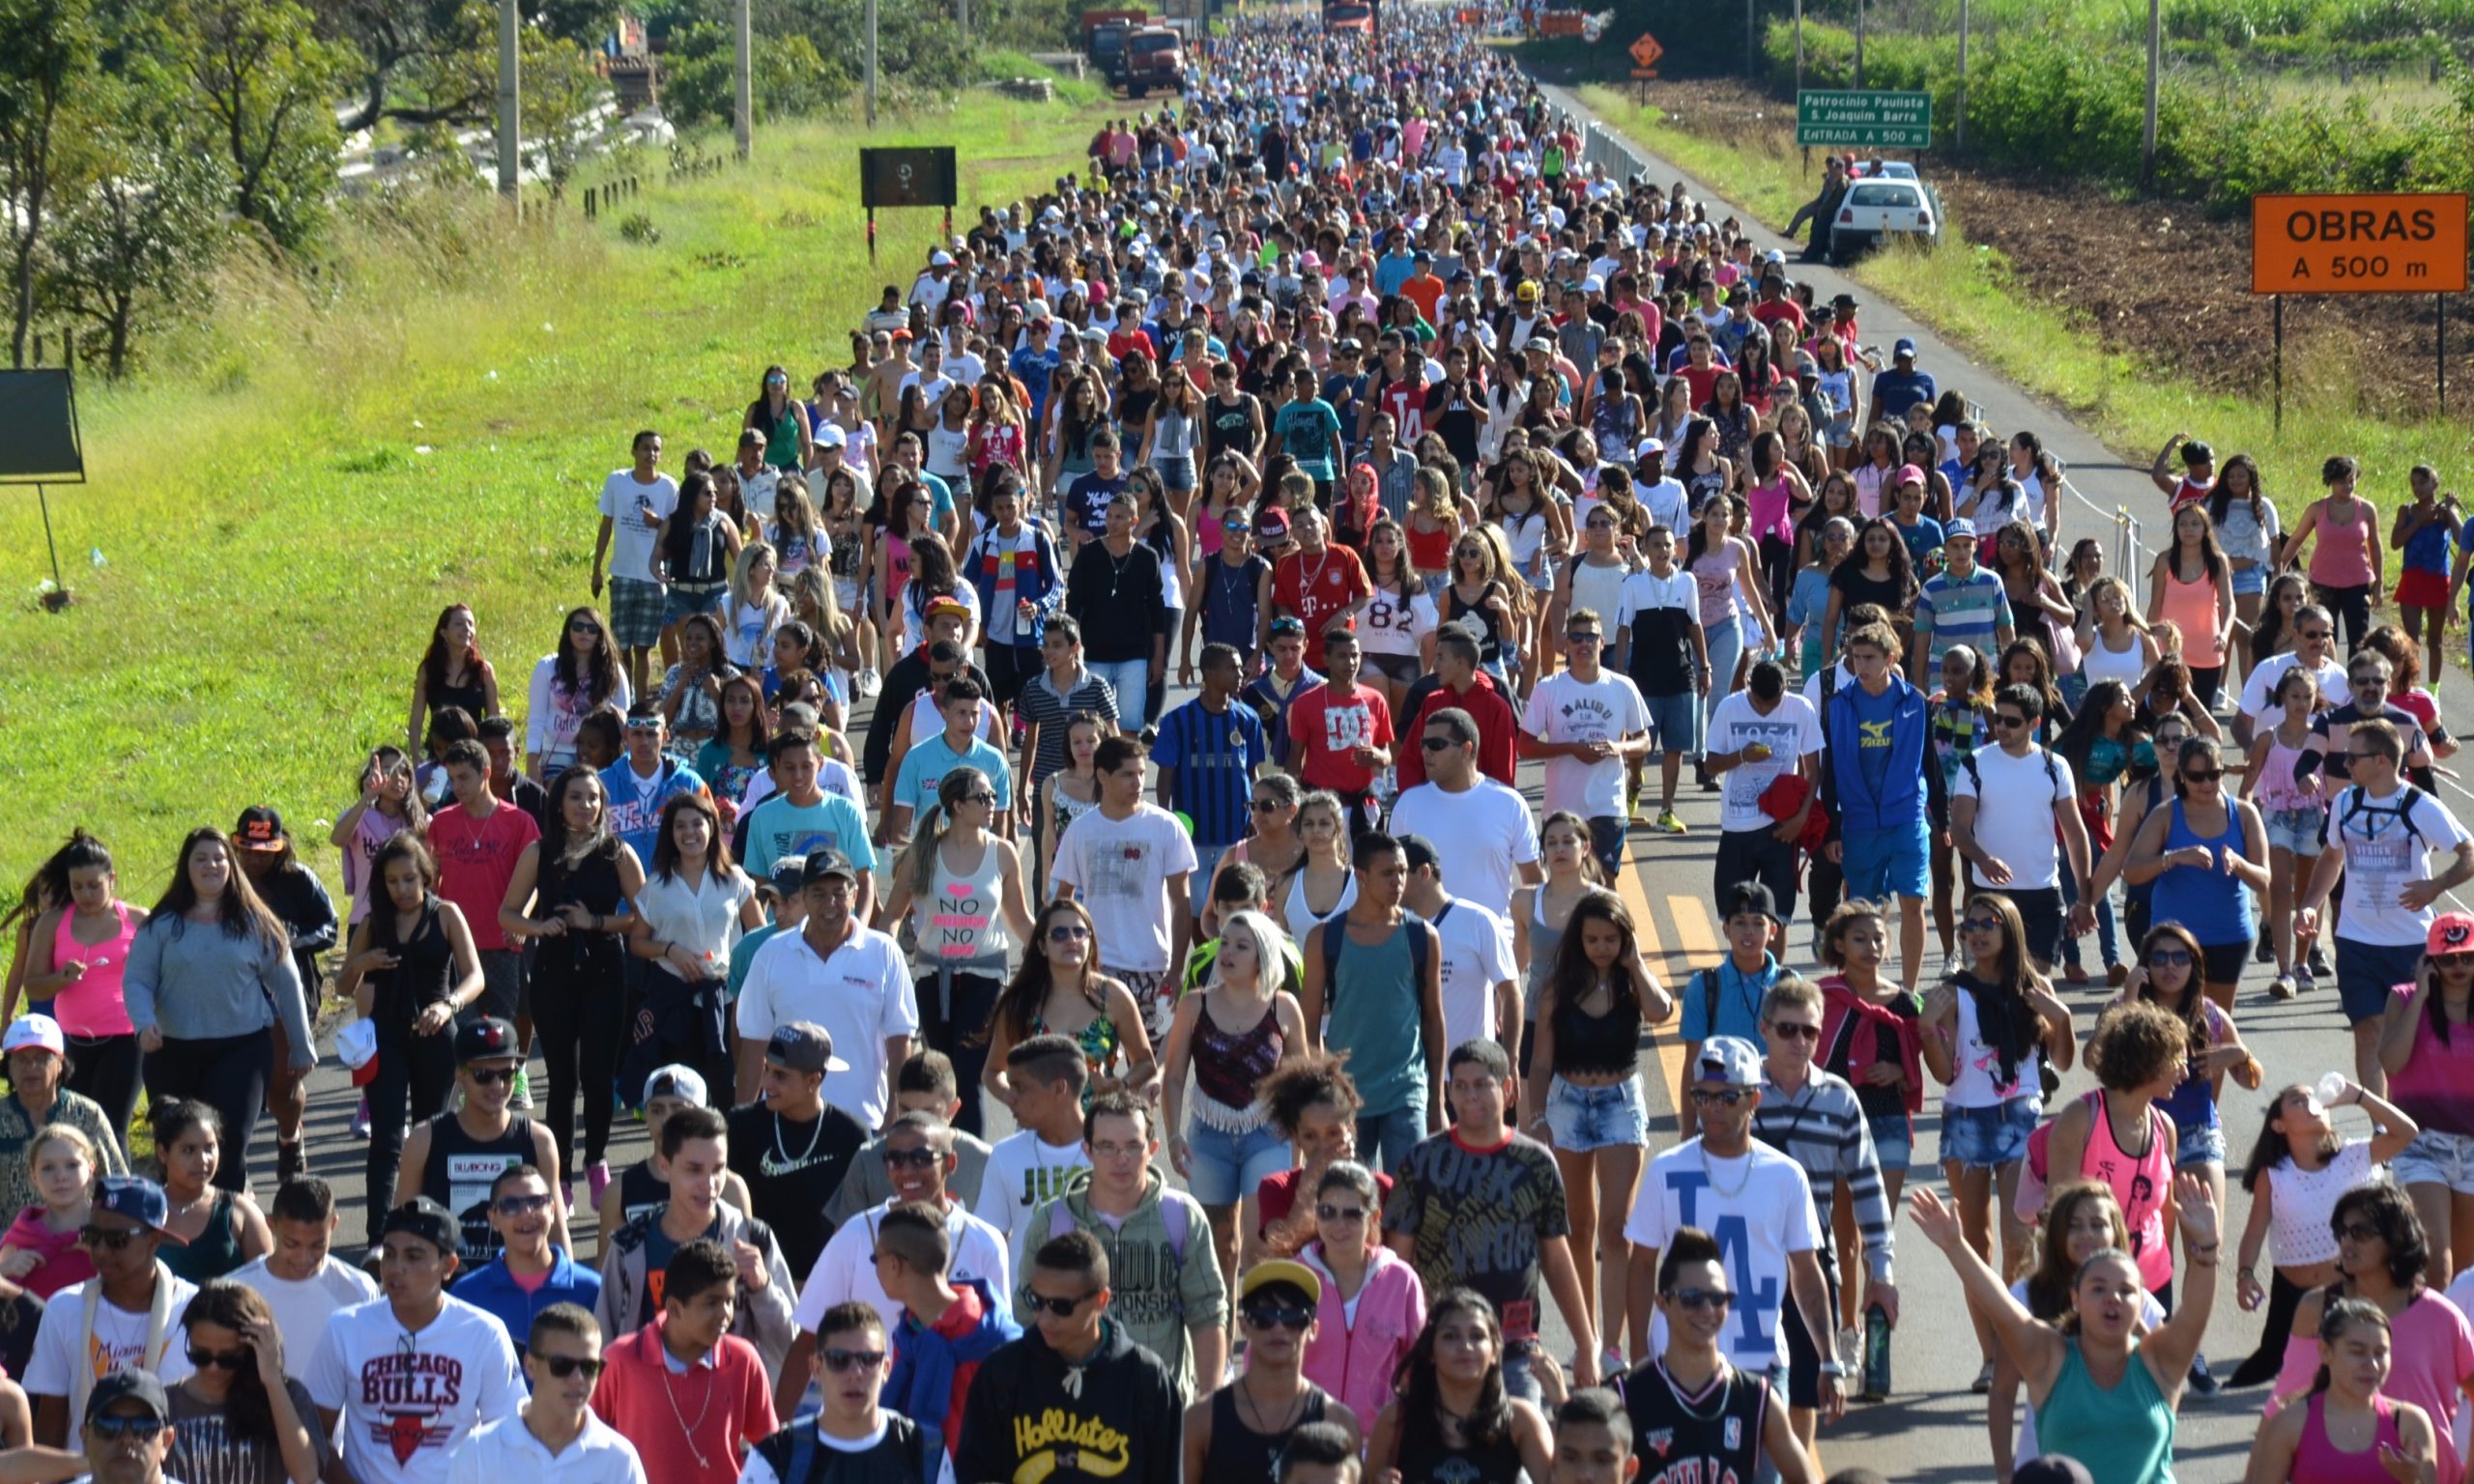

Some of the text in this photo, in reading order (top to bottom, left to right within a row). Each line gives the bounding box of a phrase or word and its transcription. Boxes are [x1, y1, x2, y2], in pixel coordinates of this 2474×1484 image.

[1875, 96, 1924, 108] Paulista
[1825, 109, 1876, 123] Joaquim
[1883, 110, 1917, 122] Barra
[1803, 129, 1922, 143] ENTRADA A 500 m
[2286, 208, 2435, 243] OBRAS
[2291, 255, 2428, 279] A 500 m
[1562, 699, 1613, 721] MALIBU
[940, 899, 979, 915] NO
[943, 928, 974, 944] NO
[1666, 1170, 1777, 1353] LA
[361, 1353, 462, 1384] CHICAGO
[362, 1377, 461, 1407] BULLS
[1013, 1408, 1129, 1458] Hollister
